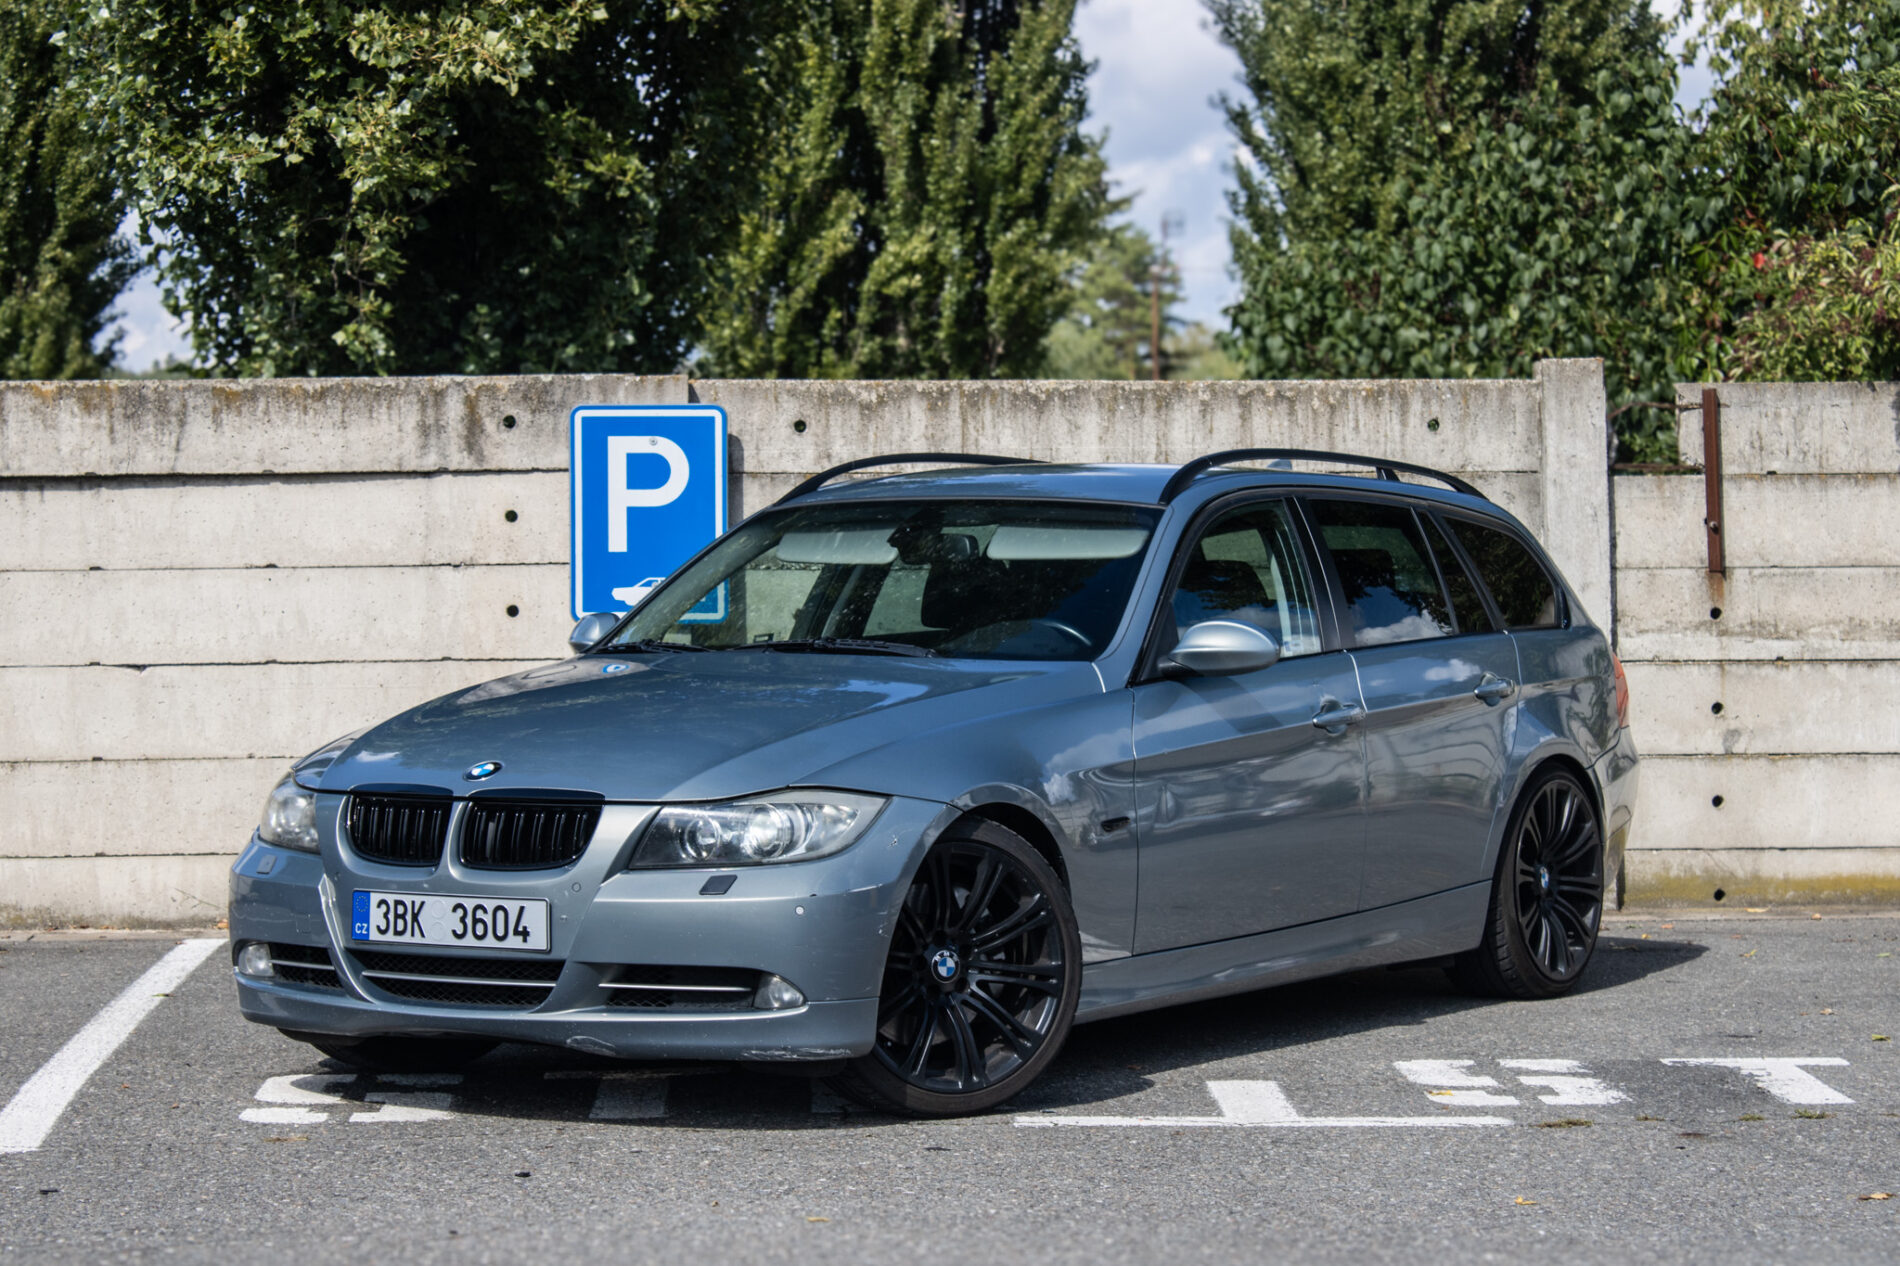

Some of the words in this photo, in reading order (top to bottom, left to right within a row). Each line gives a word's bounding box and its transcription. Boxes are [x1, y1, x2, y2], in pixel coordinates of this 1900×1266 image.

[608, 436, 690, 552] P
[355, 922, 368, 934] CZ
[376, 898, 426, 938] 3BK
[452, 902, 530, 942] 3604
